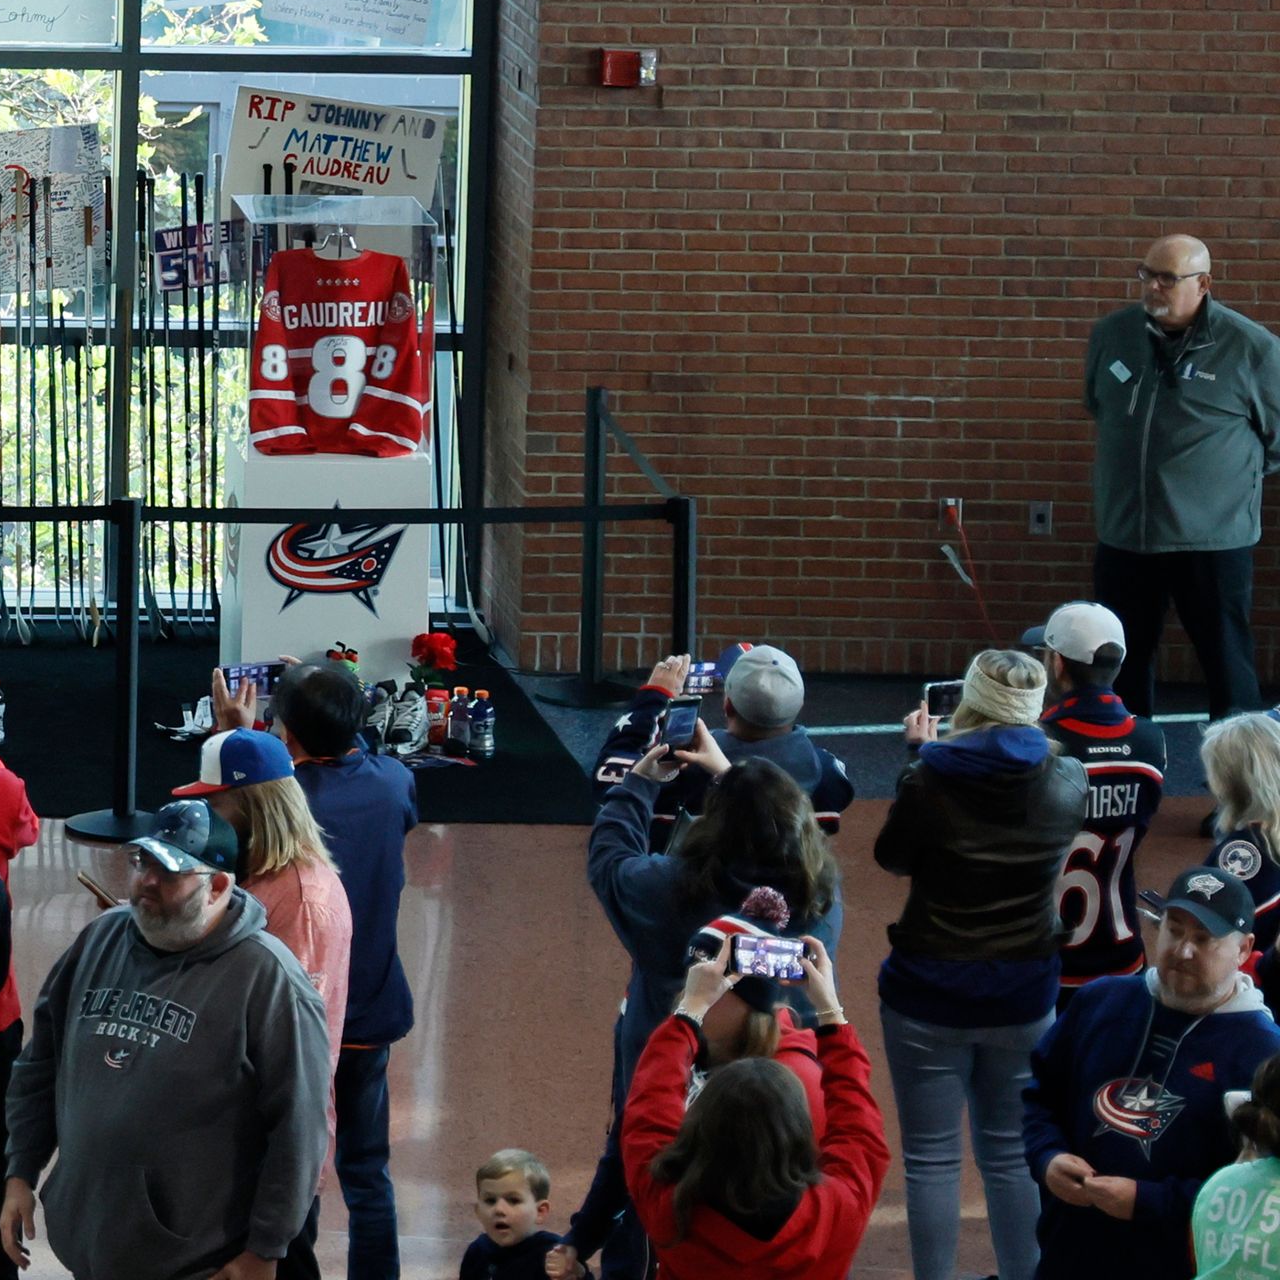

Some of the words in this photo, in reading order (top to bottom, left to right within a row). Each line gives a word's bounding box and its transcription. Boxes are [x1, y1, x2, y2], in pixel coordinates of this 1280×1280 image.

[247, 94, 297, 122] RIP
[307, 102, 389, 131] JOHNNY
[391, 114, 437, 140] AND
[282, 128, 394, 165] MATTHEW
[283, 153, 390, 186] GAUDREAU
[283, 301, 389, 330] GAUDREAU
[260, 344, 289, 382] 8
[307, 334, 368, 419] 8
[370, 344, 398, 380] 8
[1060, 827, 1135, 947] 61
